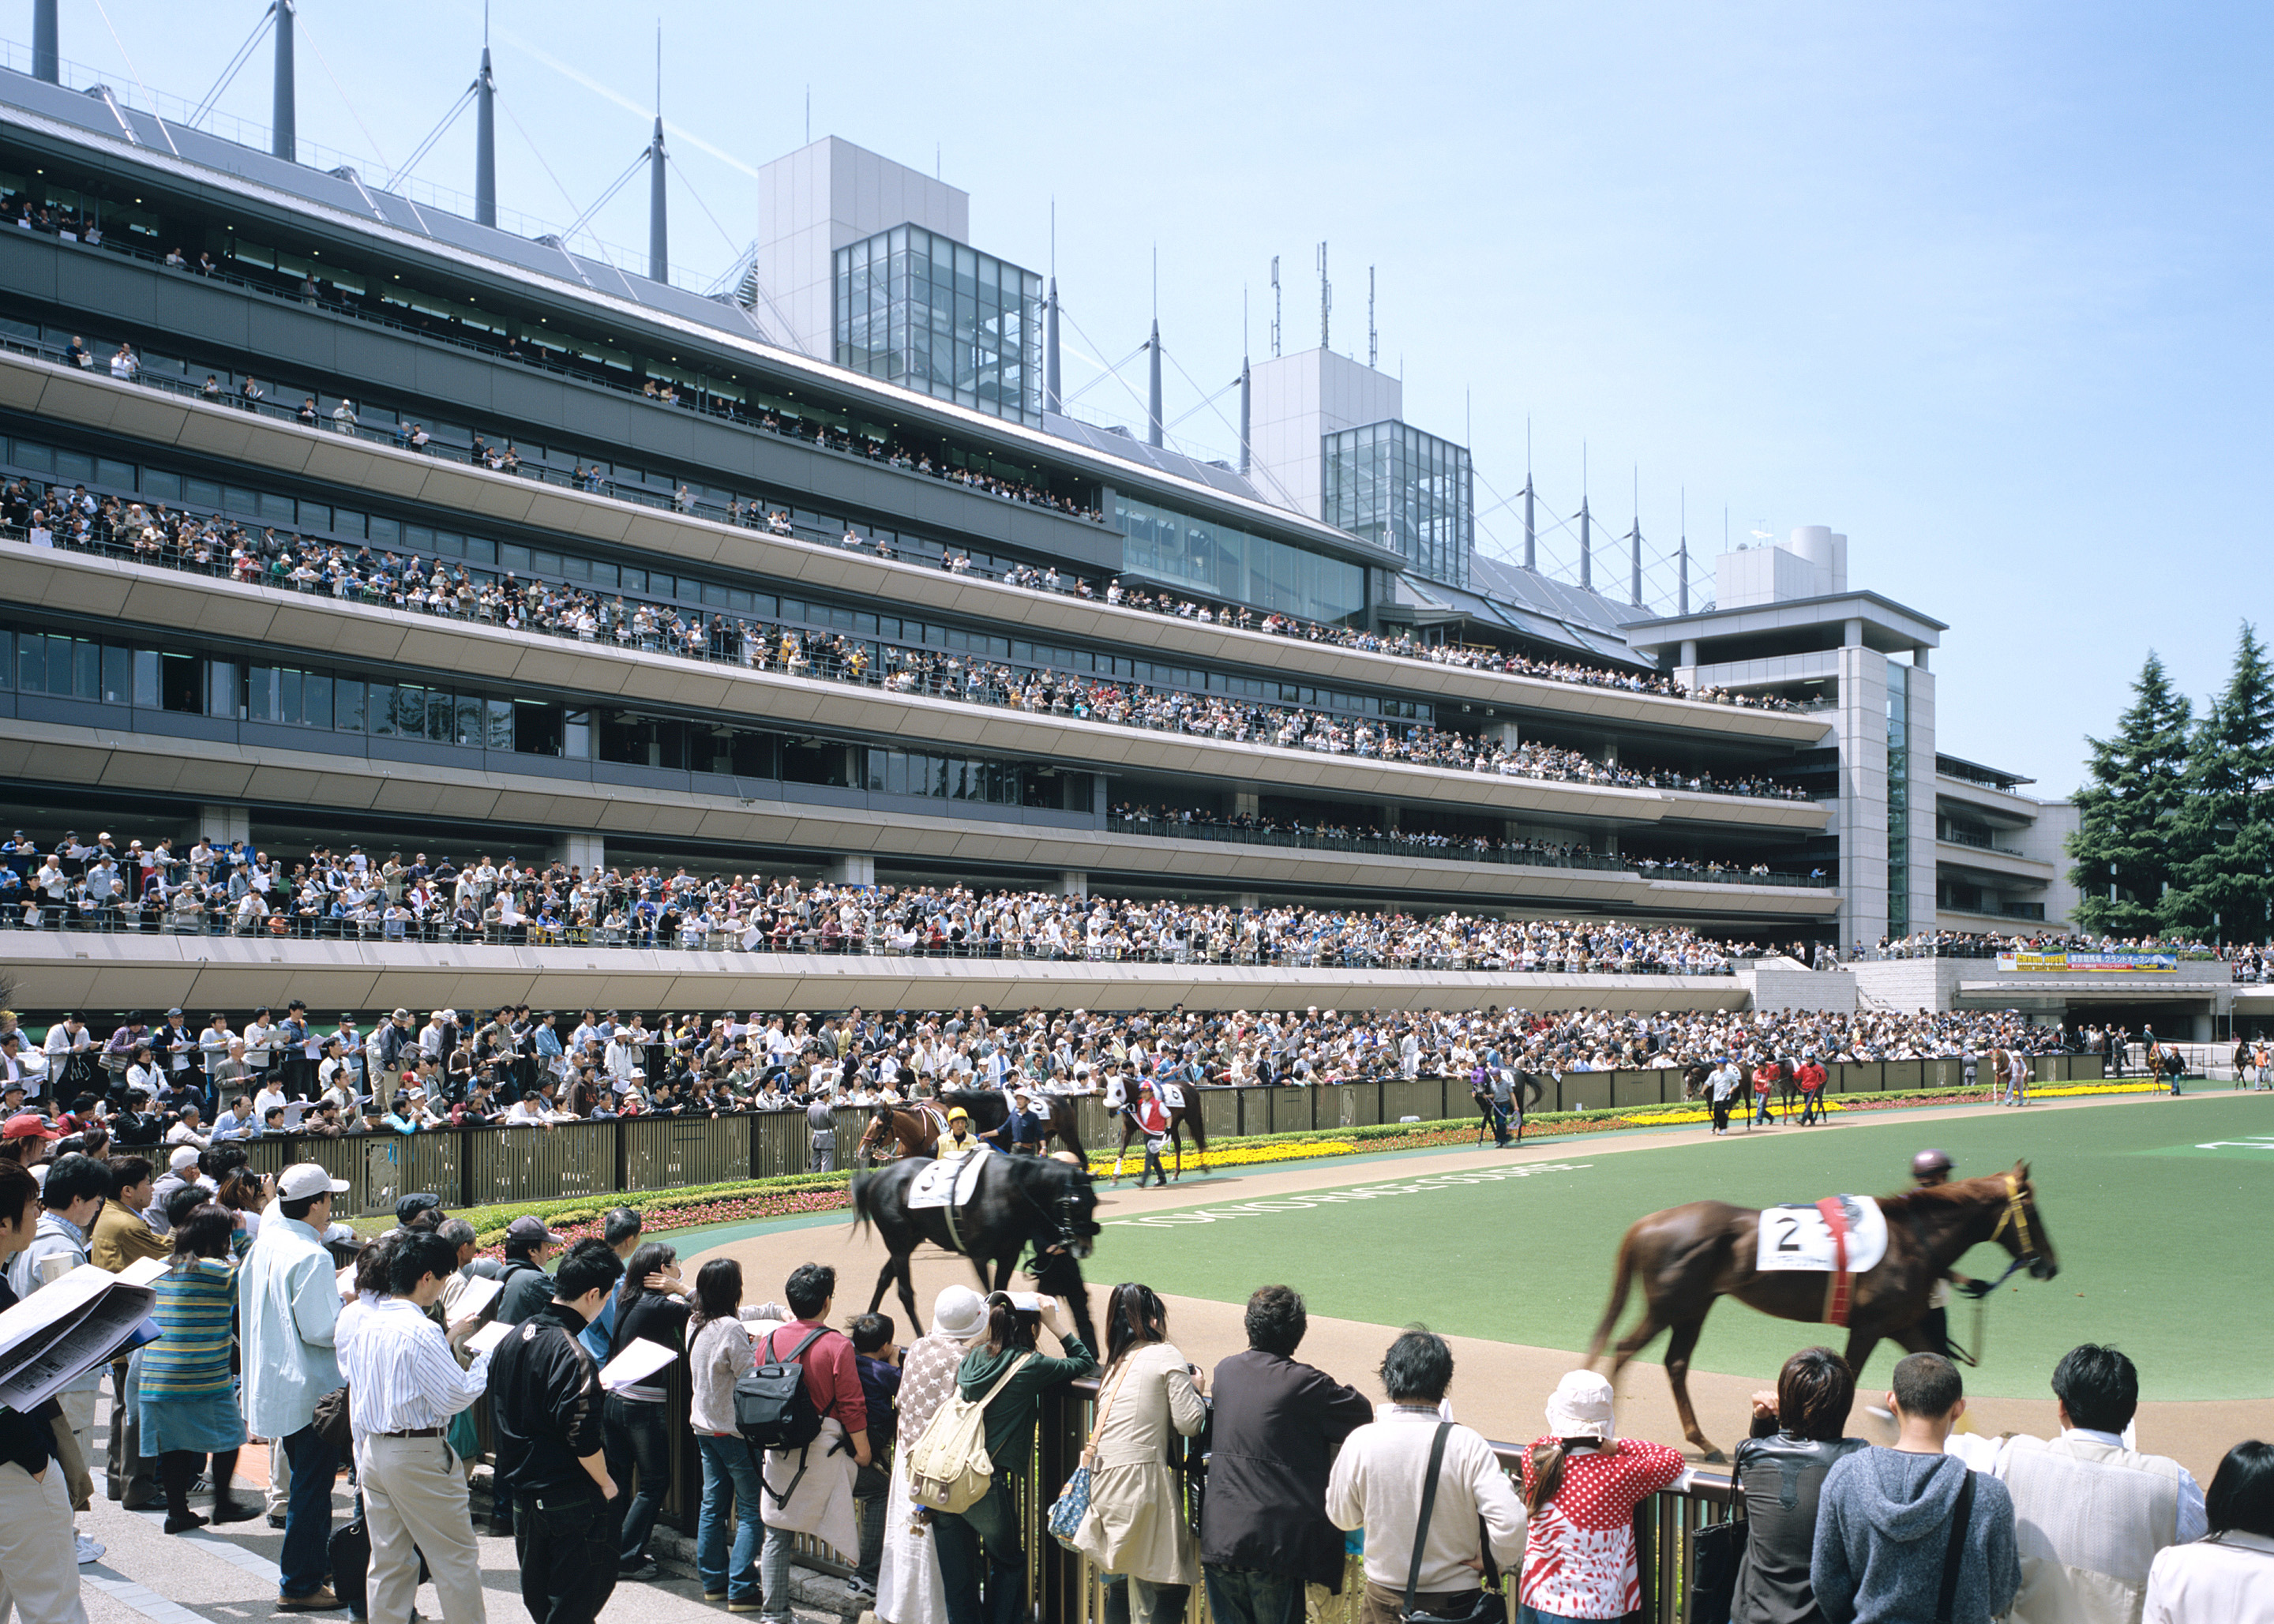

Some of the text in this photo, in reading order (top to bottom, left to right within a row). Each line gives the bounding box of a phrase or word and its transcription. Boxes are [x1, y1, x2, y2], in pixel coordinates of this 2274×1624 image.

[2017, 954, 2043, 966] GRAND
[2044, 953, 2067, 966] OPEN!
[1099, 1201, 1318, 1228] TOKYO
[1289, 1183, 1449, 1202] RACE
[1777, 1217, 1800, 1251] 2
